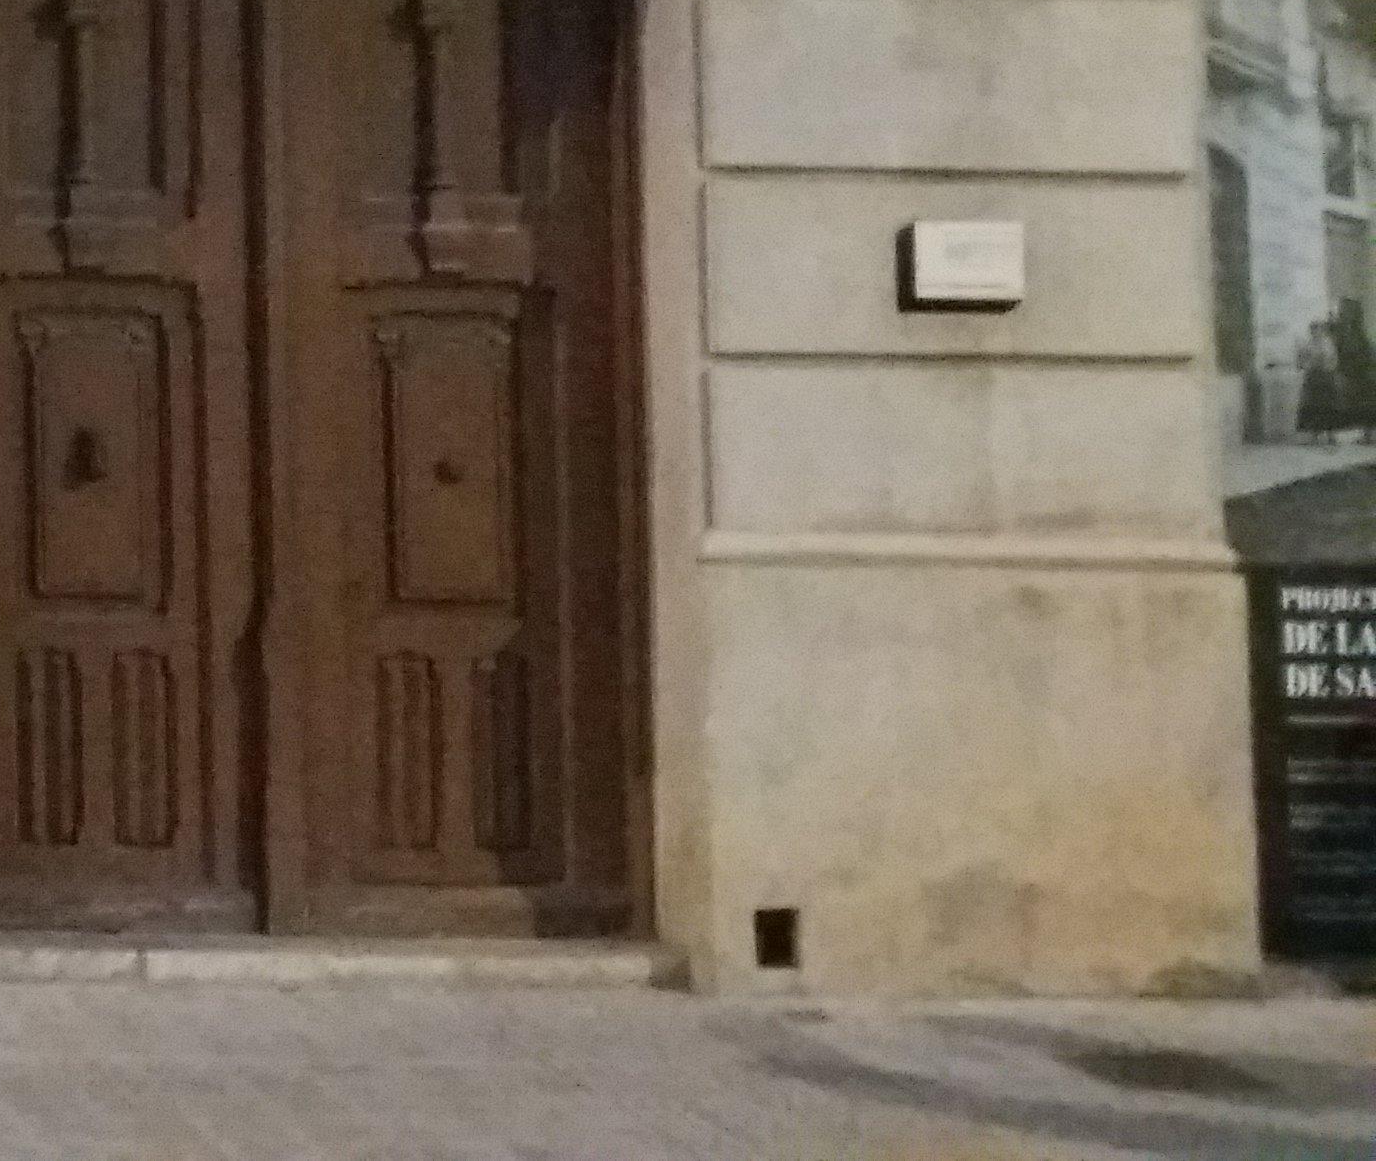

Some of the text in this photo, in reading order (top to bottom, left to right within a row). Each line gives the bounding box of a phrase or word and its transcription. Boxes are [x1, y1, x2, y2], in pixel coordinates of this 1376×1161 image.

[1284, 621, 1376, 655] DE LA
[1286, 664, 1376, 698] DE SA
